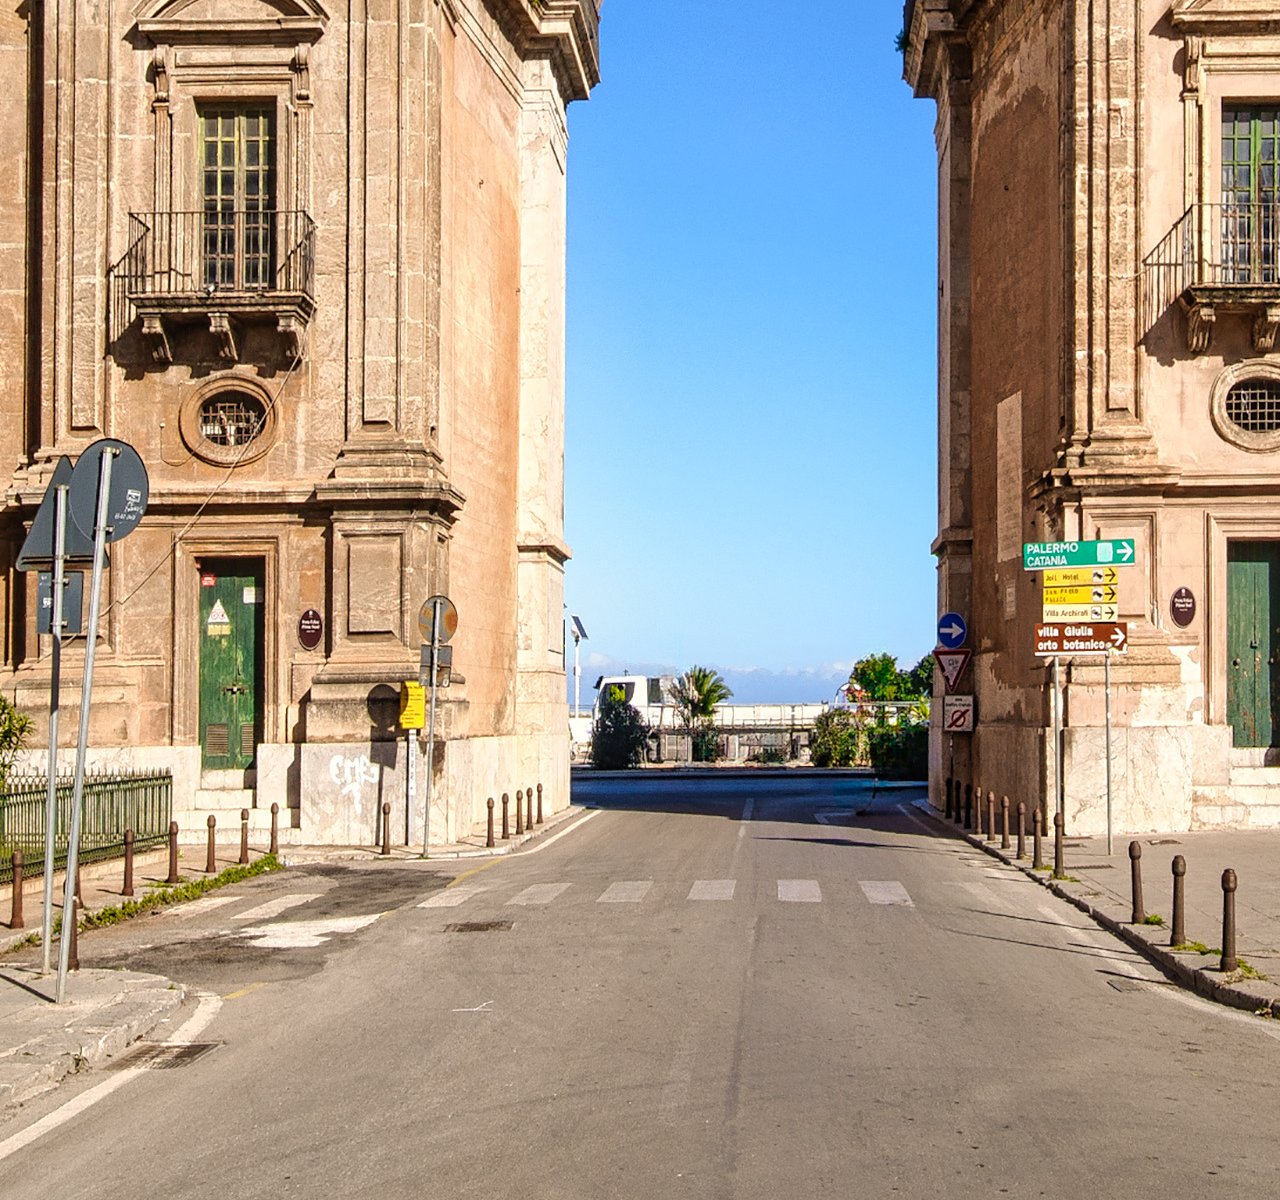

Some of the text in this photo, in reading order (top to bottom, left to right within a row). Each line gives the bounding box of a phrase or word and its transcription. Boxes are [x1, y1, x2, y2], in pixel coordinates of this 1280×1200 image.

[1026, 542, 1079, 555] PALERMO
[1026, 555, 1068, 567] CATANIA
[1062, 573, 1079, 581] Hotel
[1045, 609, 1059, 617] Villa
[1037, 625, 1094, 637] villa Giulia
[1037, 639, 1105, 651] orto botanico
